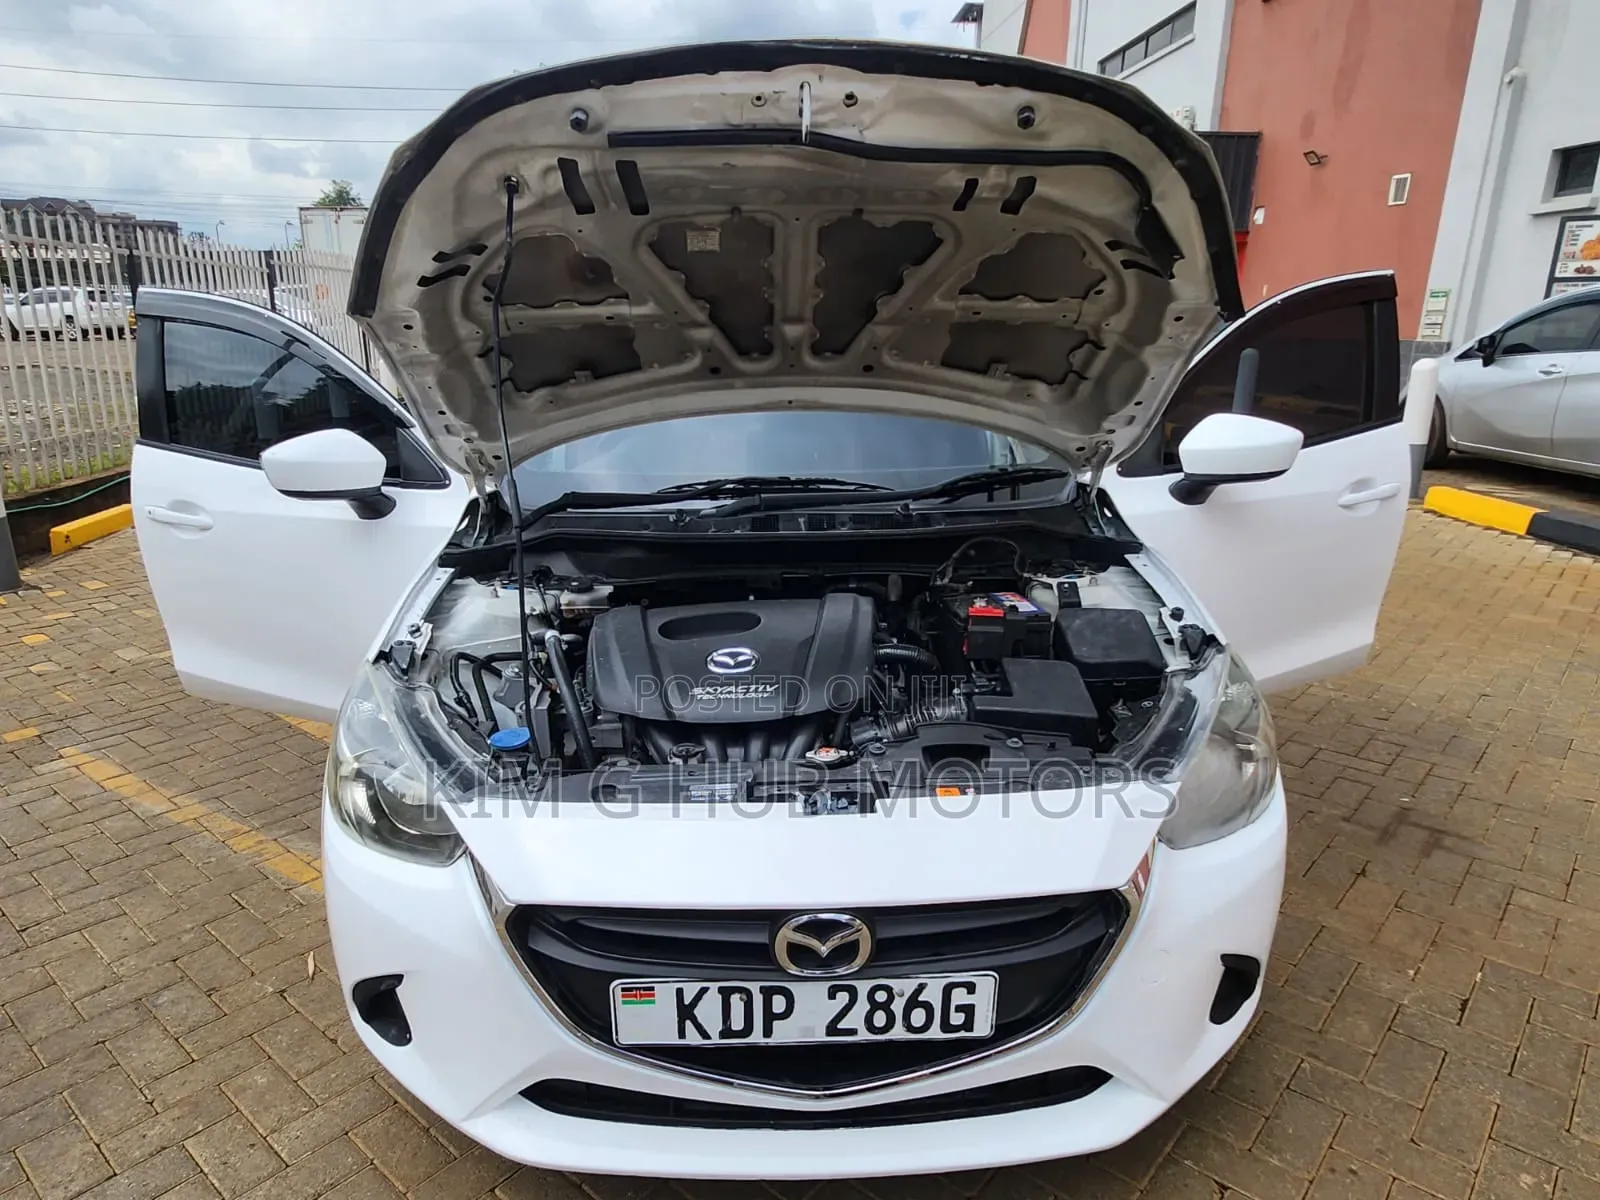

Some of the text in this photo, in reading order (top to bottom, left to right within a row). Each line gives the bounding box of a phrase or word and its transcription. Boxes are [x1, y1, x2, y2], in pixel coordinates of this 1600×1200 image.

[689, 684, 779, 696] SKYACTIV
[696, 691, 771, 700] TECHNOLOGY
[675, 985, 796, 1040] KDP
[825, 981, 977, 1037] 286G
